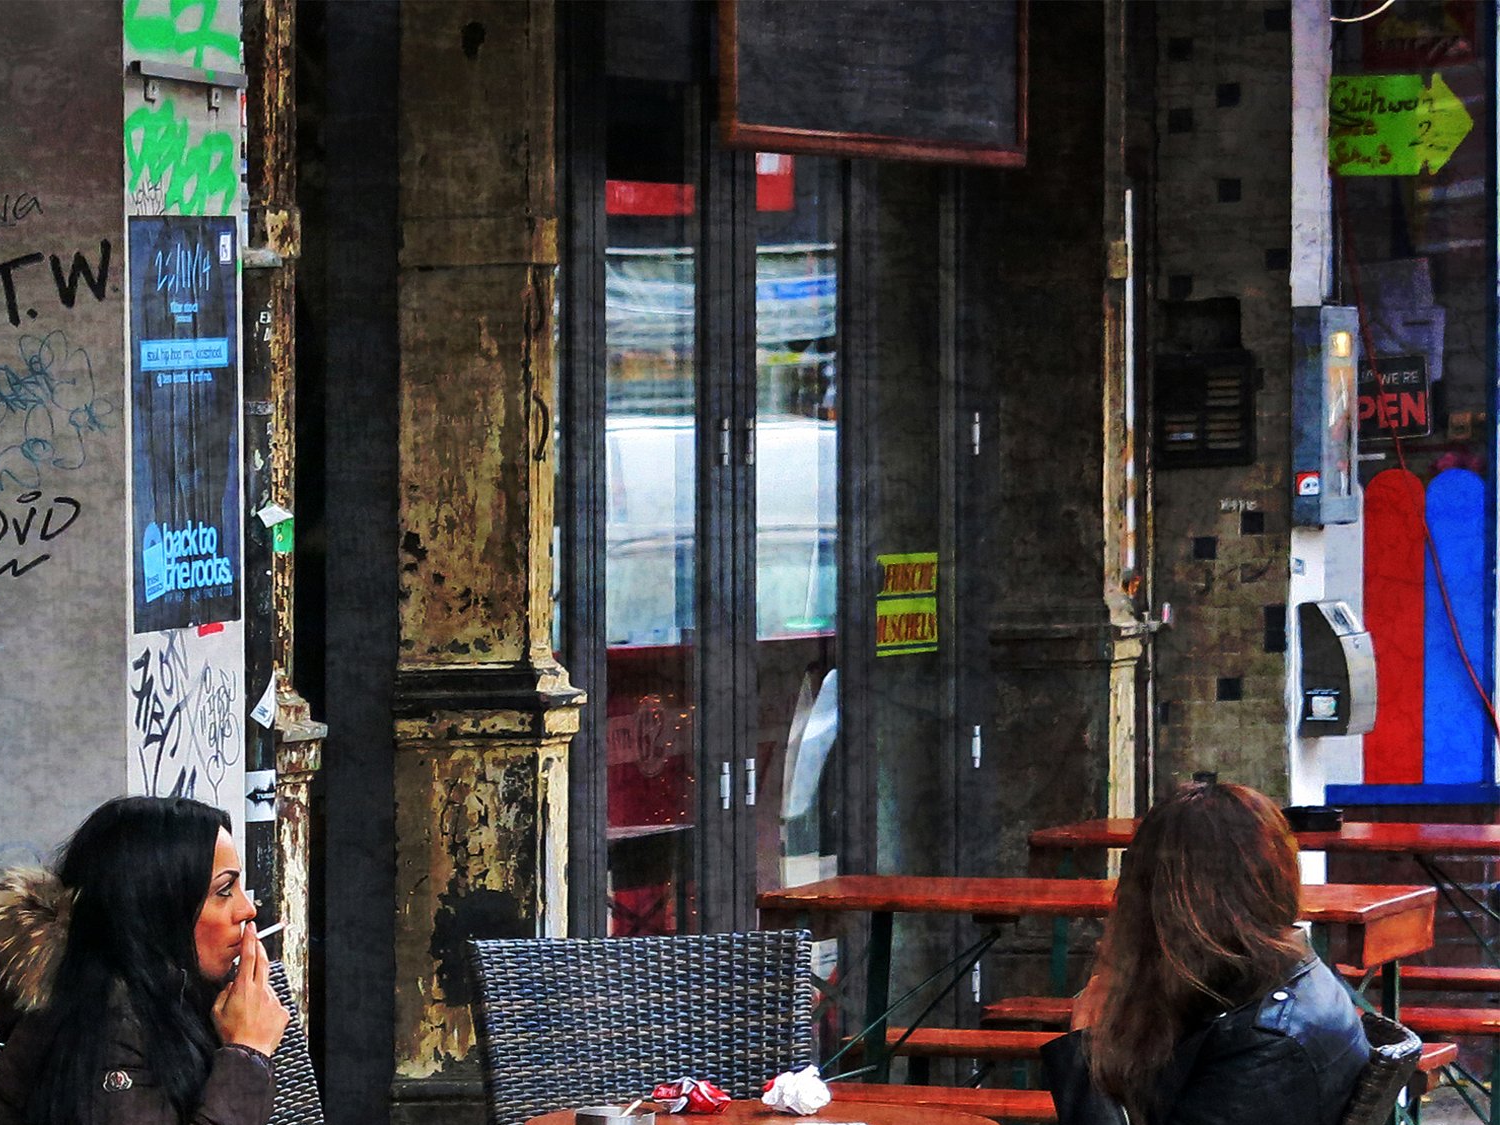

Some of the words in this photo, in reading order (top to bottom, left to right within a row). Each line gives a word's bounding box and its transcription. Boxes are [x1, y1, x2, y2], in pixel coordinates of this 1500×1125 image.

[1357, 391, 1427, 428] PEN
[162, 520, 198, 559] back
[199, 521, 218, 556] to
[164, 556, 191, 592] the
